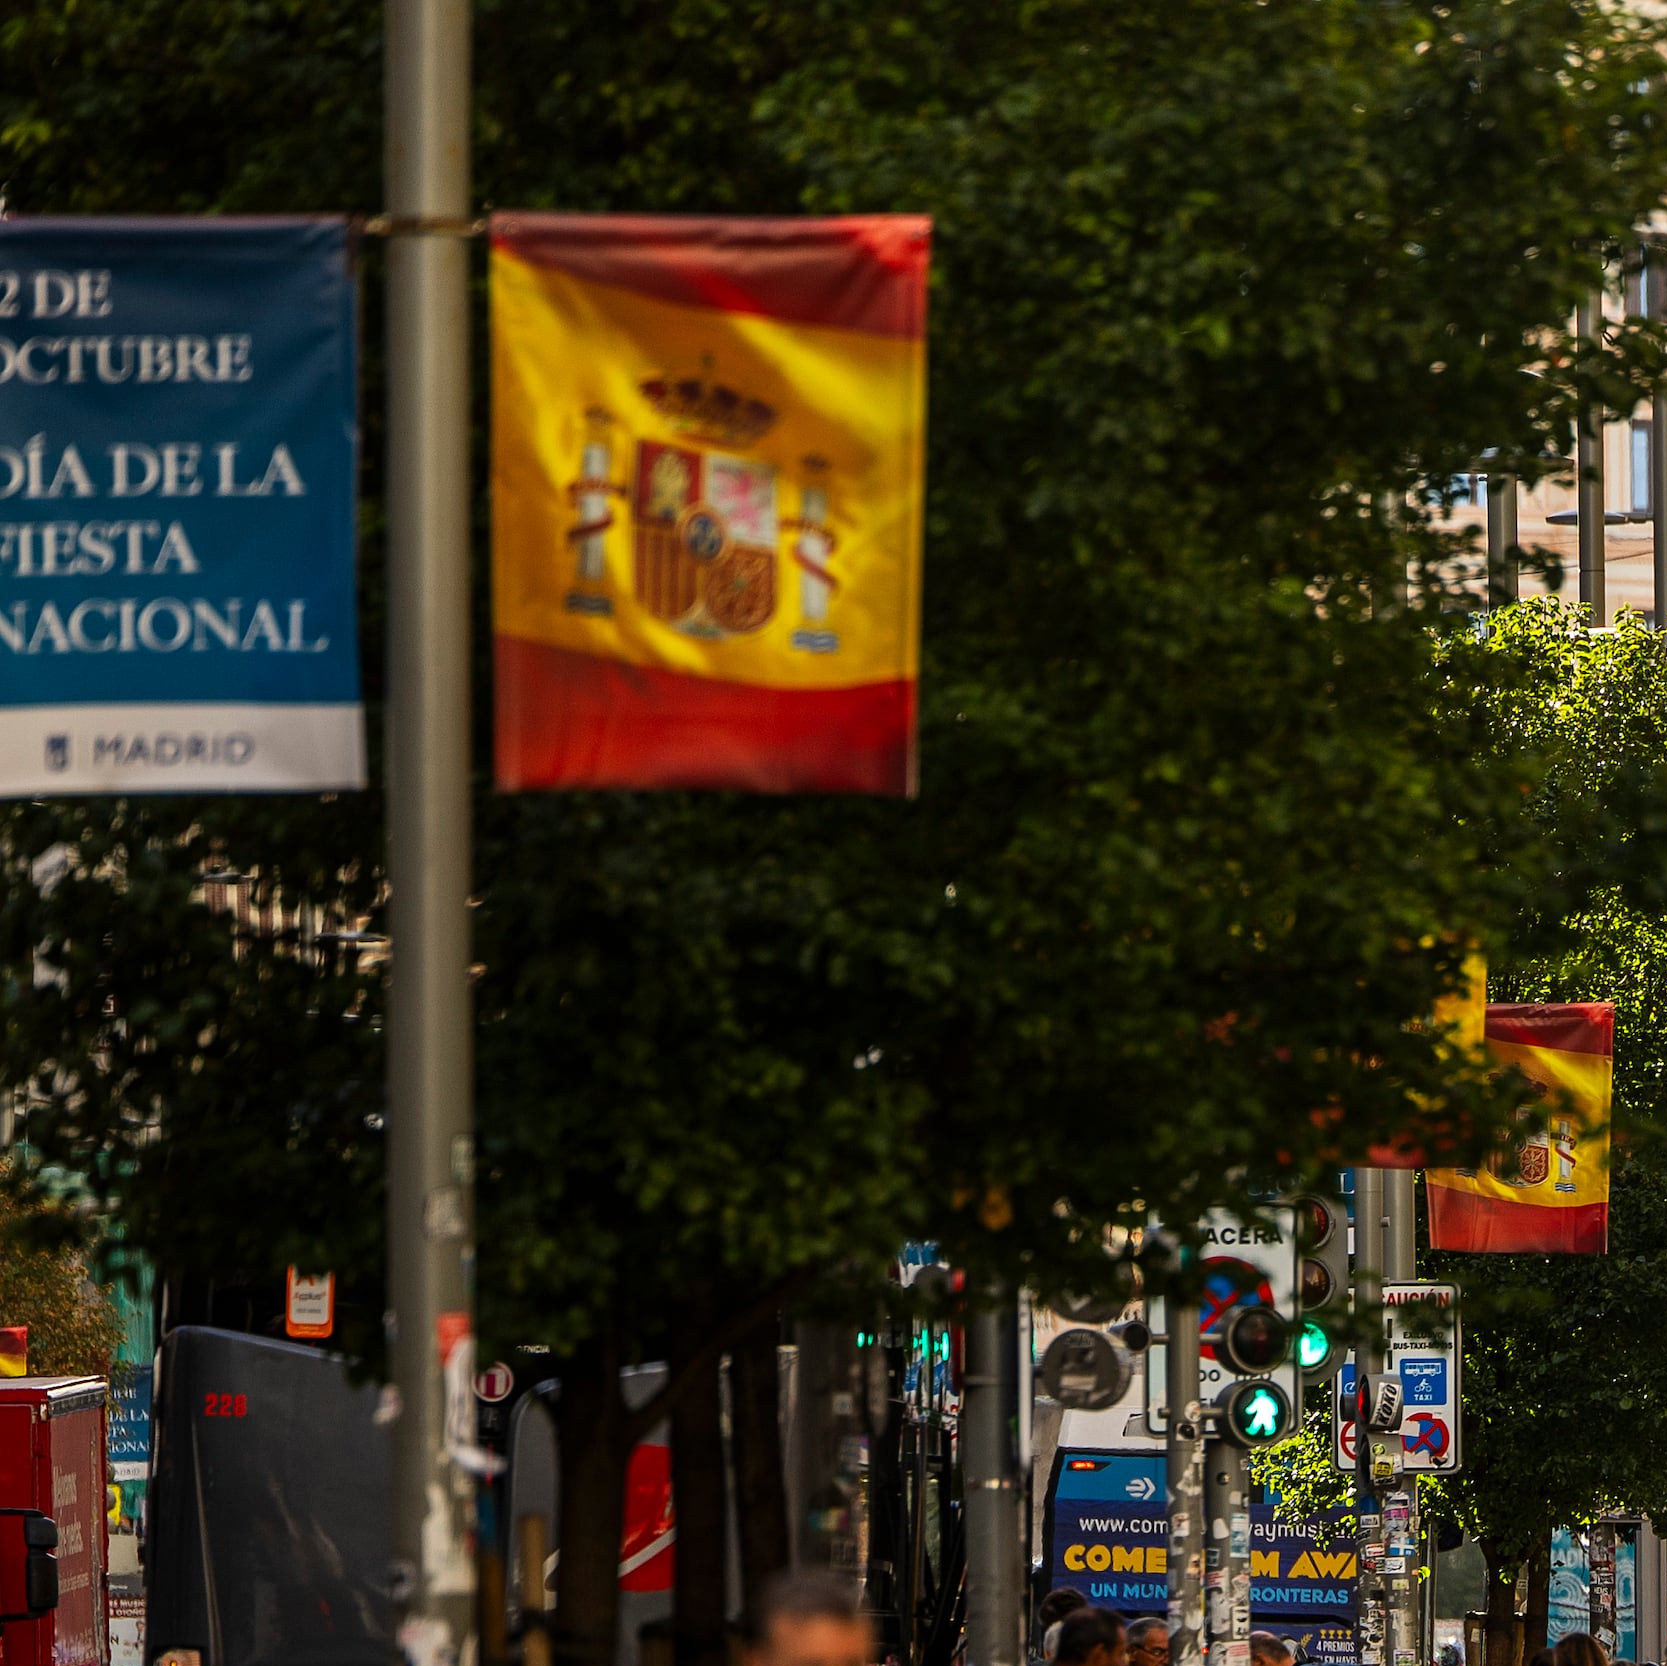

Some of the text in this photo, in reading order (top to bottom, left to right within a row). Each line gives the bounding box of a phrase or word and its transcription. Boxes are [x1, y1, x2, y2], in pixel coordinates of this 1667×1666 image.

[33, 269, 113, 318] DE
[108, 442, 203, 498] DE
[213, 442, 305, 497] LA
[93, 731, 256, 767] MADRID
[204, 1393, 248, 1418] 228
[1414, 1394, 1433, 1402] TAXI
[1063, 1544, 1167, 1574] COME
[1090, 1583, 1119, 1599] UN
[1316, 1641, 1355, 1653] 4 PREMIOS
